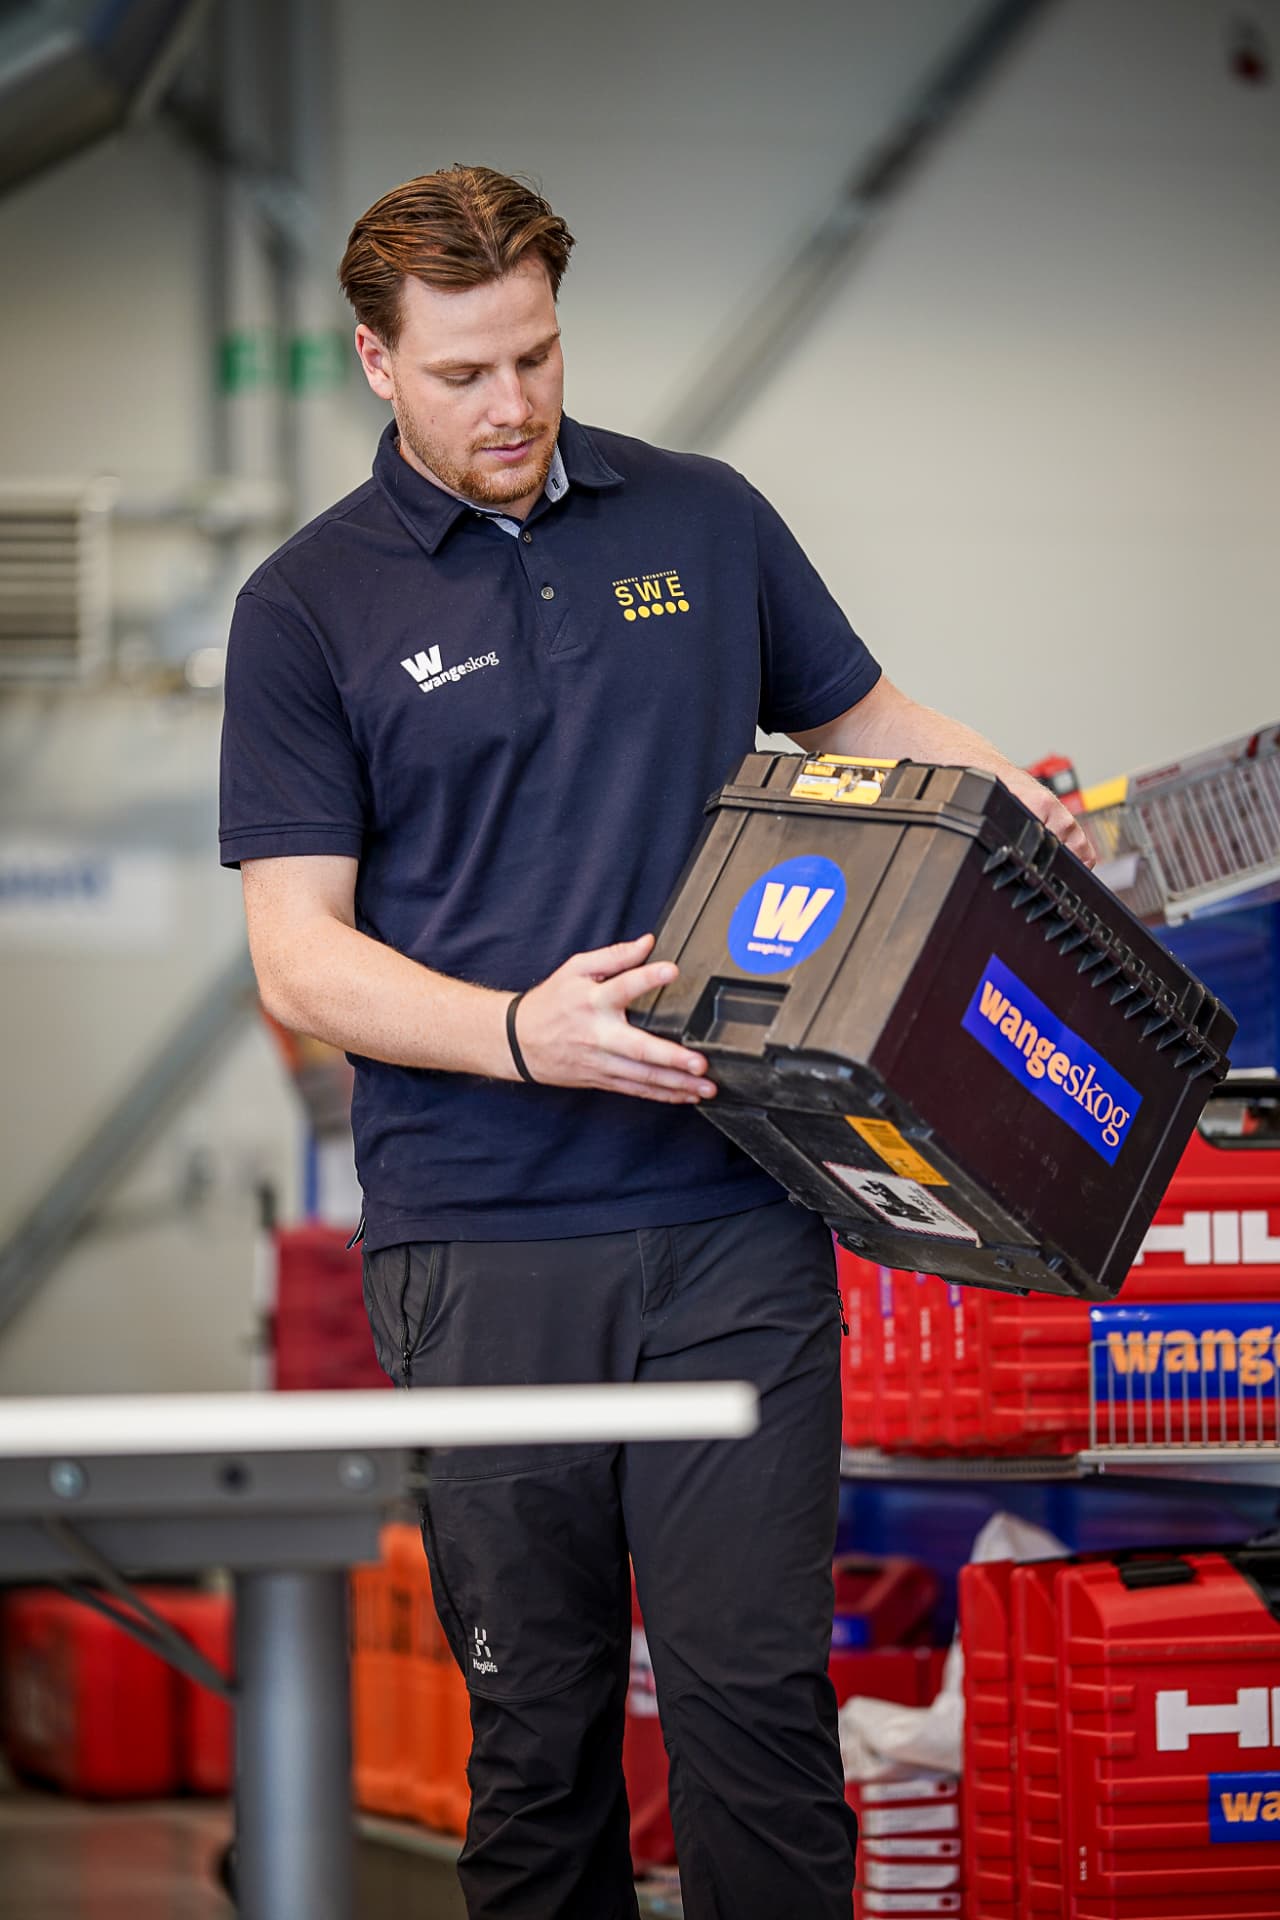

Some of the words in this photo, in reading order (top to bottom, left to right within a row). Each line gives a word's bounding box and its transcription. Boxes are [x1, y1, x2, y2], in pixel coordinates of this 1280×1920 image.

[614, 575, 685, 606] SWE
[400, 644, 443, 683] W
[418, 651, 500, 693] wangeskog
[752, 882, 835, 942] W
[978, 980, 1130, 1147] wangeskog
[1107, 1325, 1280, 1386] wang
[1155, 1686, 1280, 1752] H
